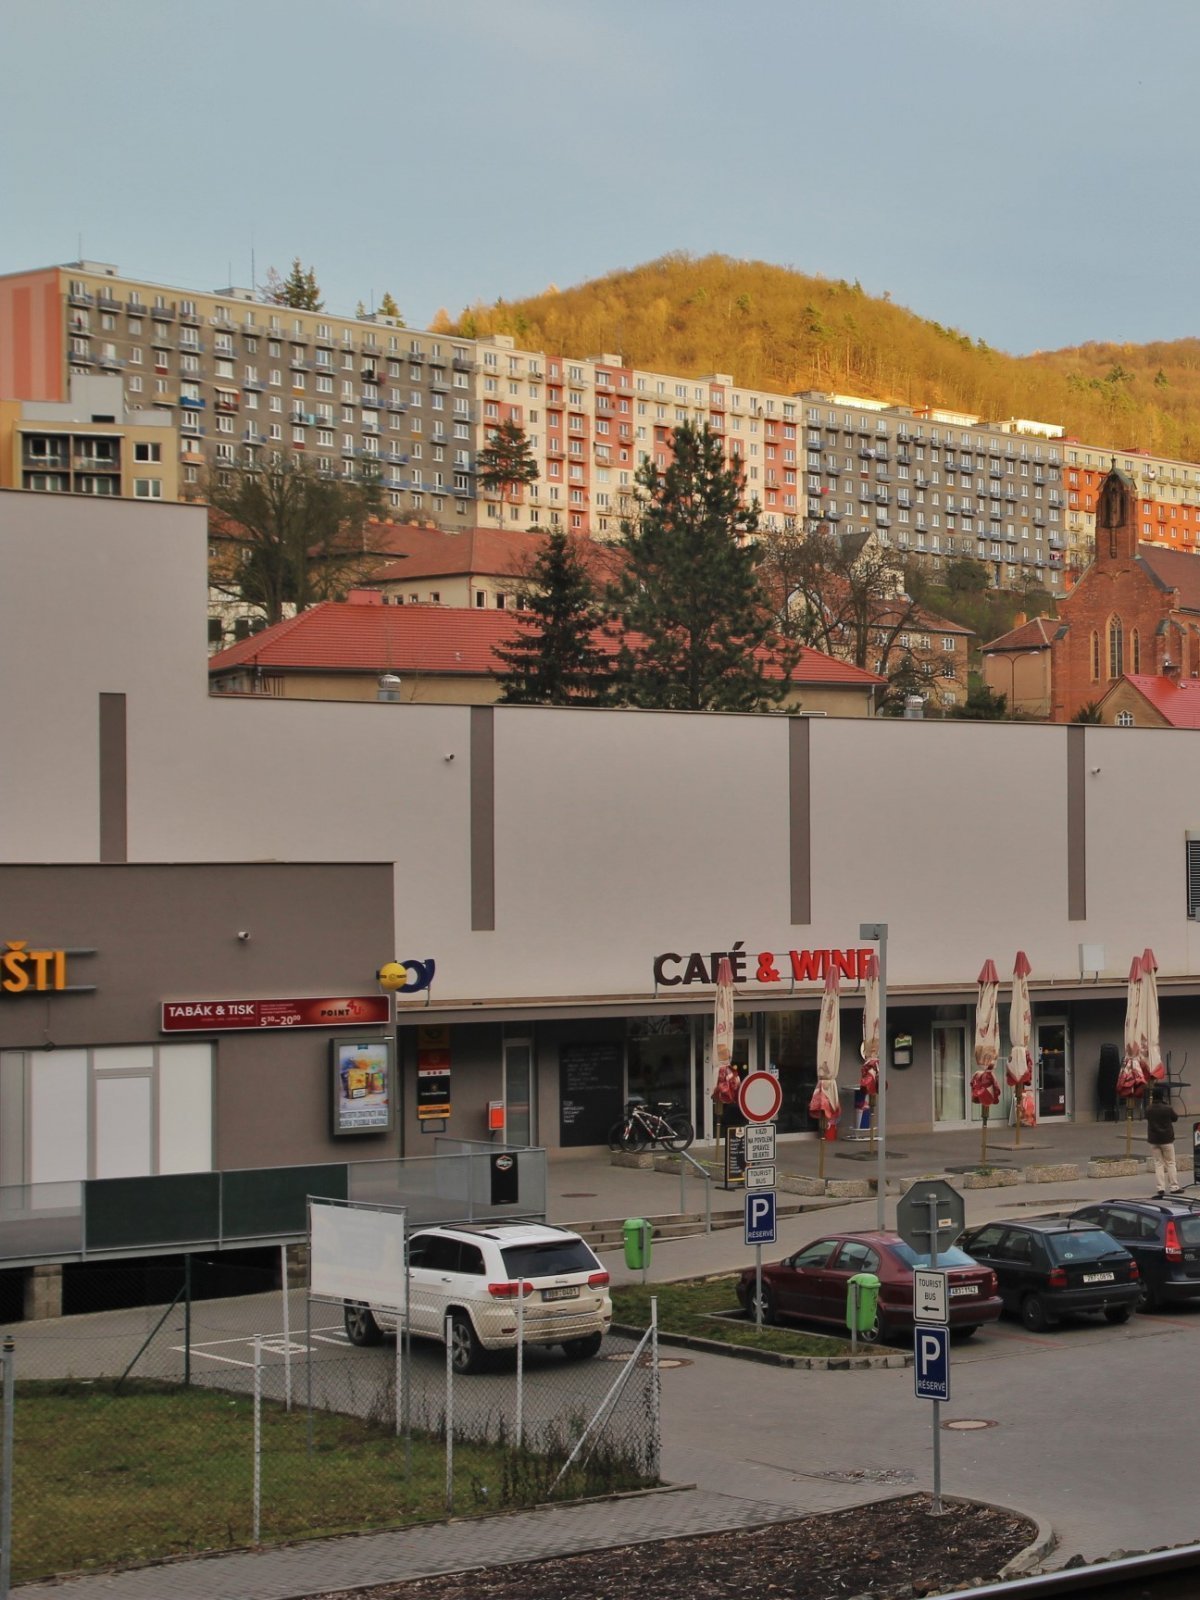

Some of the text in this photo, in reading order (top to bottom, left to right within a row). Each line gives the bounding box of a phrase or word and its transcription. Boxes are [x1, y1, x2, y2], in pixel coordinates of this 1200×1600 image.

[653, 941, 747, 986] CAFÉ
[756, 952, 781, 983] &
[169, 1004, 212, 1017] TABÁK
[215, 1005, 226, 1016] &
[228, 1004, 255, 1015] TISK
[320, 1008, 350, 1017] POINT
[750, 1169, 772, 1177] TOURIST
[752, 1199, 769, 1228] P
[919, 1278, 942, 1289] TOURIST
[924, 1292, 936, 1301] BUS
[921, 1335, 941, 1375] P
